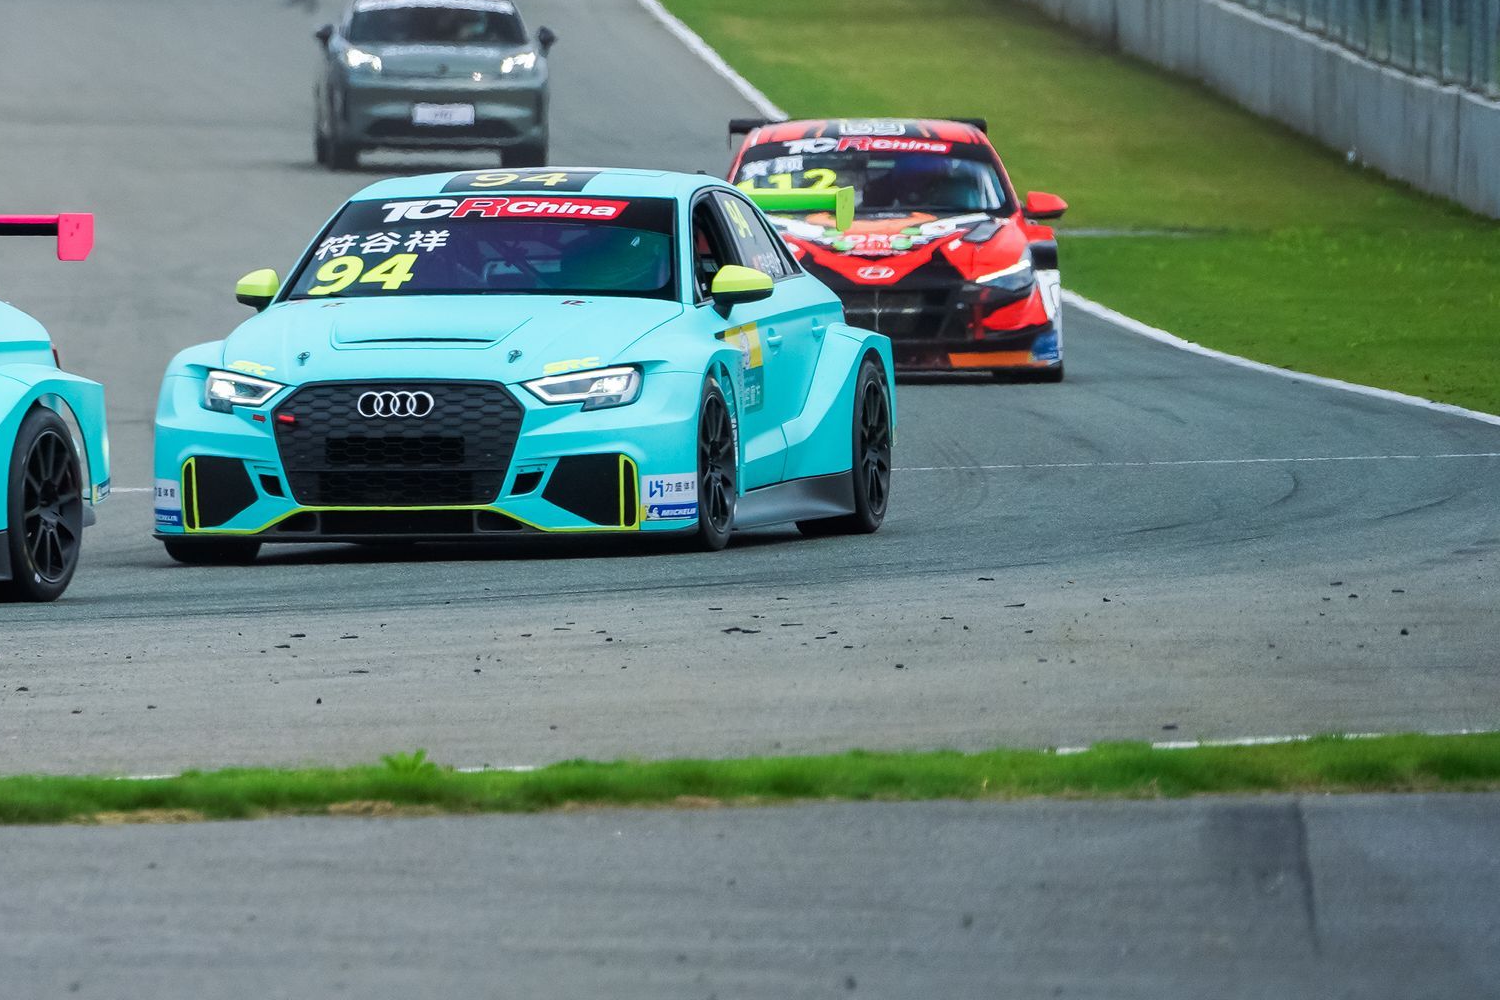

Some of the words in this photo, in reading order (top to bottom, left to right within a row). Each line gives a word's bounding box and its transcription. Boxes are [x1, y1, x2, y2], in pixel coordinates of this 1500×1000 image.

[468, 172, 569, 188] 94
[382, 198, 509, 223] TCR
[507, 201, 617, 216] China
[315, 229, 450, 260] 符谷祥
[307, 253, 418, 296] 94
